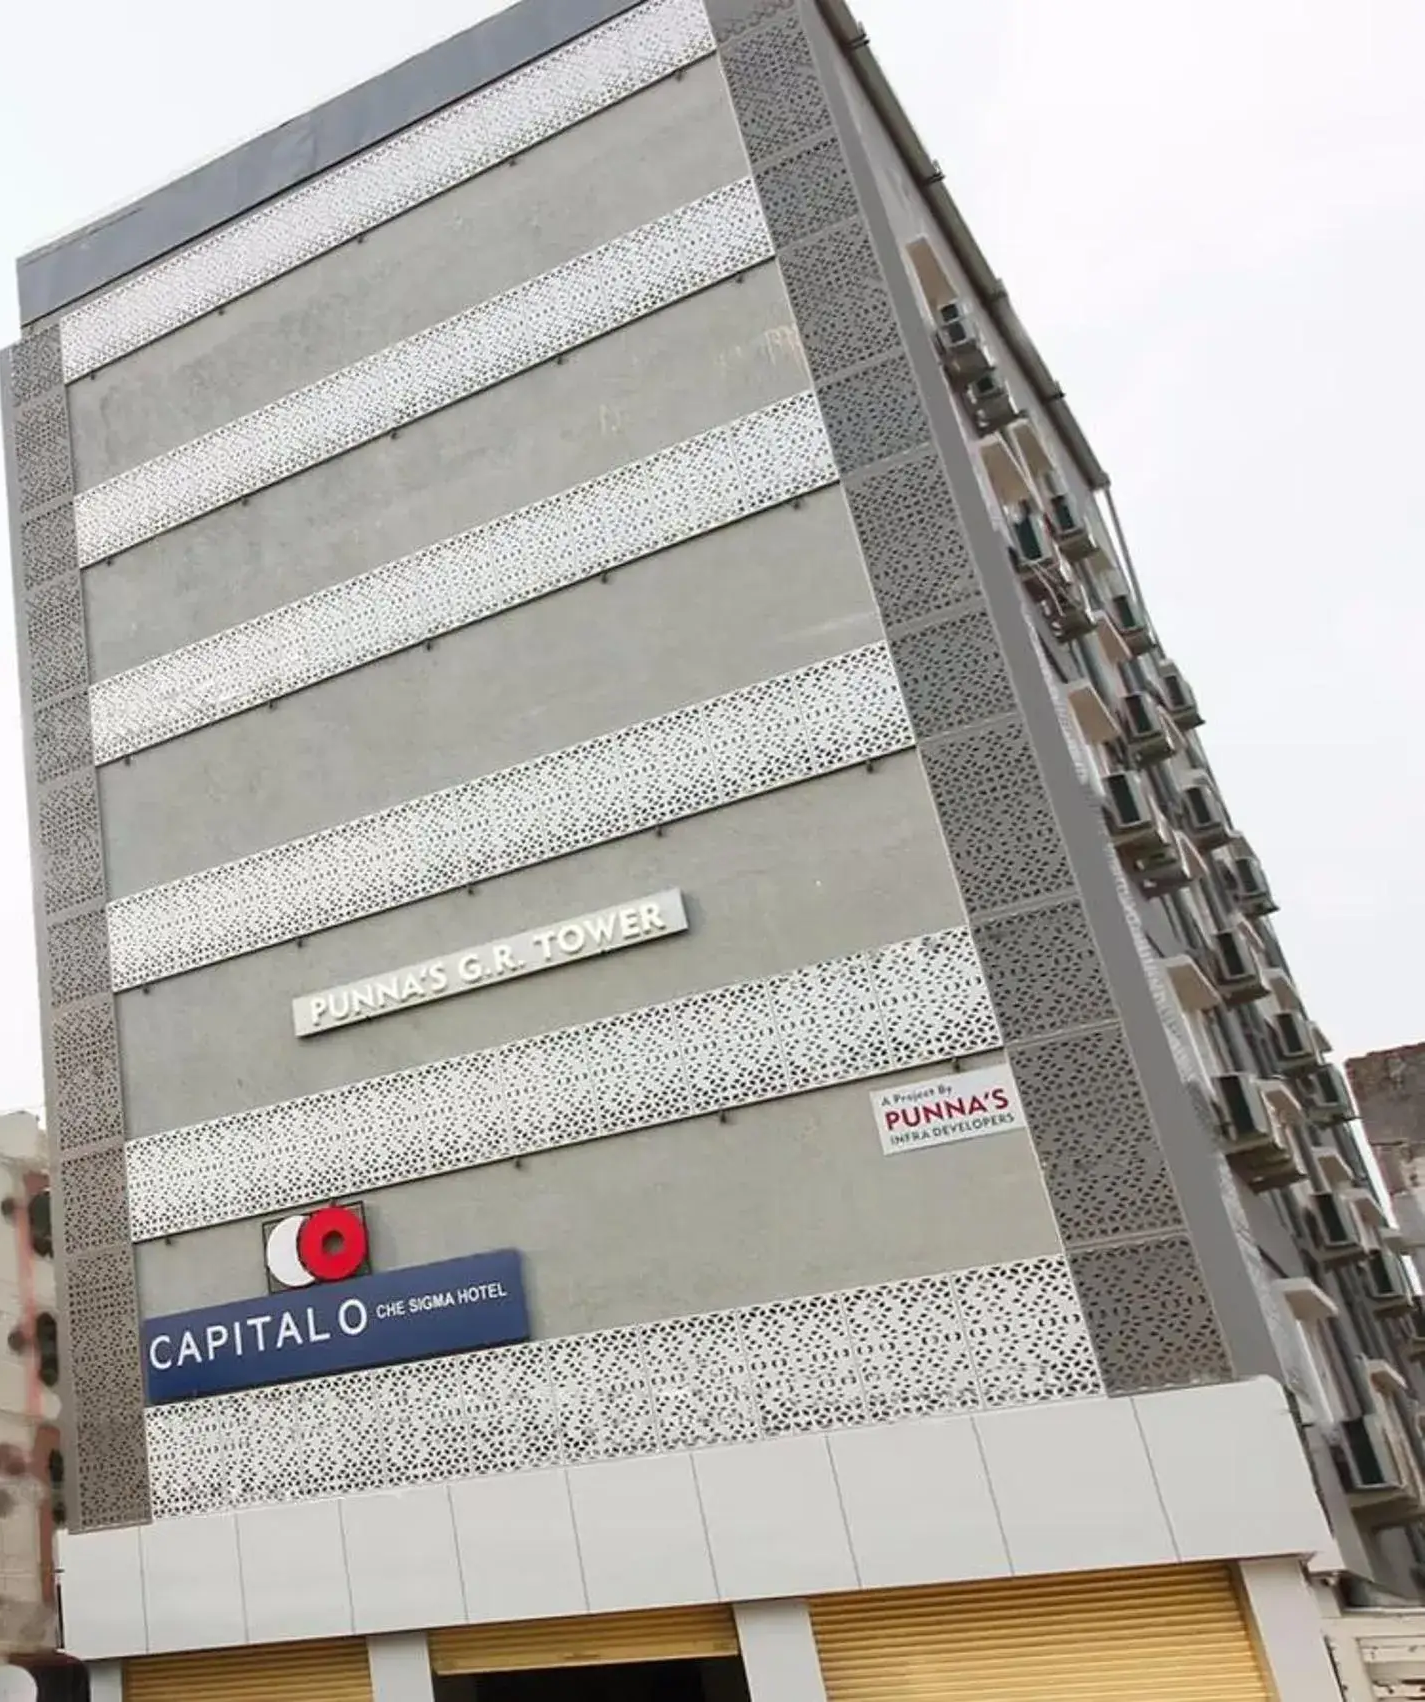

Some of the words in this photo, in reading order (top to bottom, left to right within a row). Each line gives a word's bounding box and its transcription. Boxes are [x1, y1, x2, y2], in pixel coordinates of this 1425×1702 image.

[310, 964, 447, 1025] PUNNA'S
[458, 944, 525, 984] G.R.
[534, 901, 666, 962] TOWER
[885, 1088, 1009, 1130] PUNNA'S
[890, 1131, 930, 1145] INFRA
[933, 1111, 1015, 1137] DEVELOPERS
[408, 1292, 455, 1313] SIGMA
[457, 1281, 508, 1305] HOTEL
[149, 1306, 331, 1370] CAPITAL
[338, 1298, 368, 1336] O
